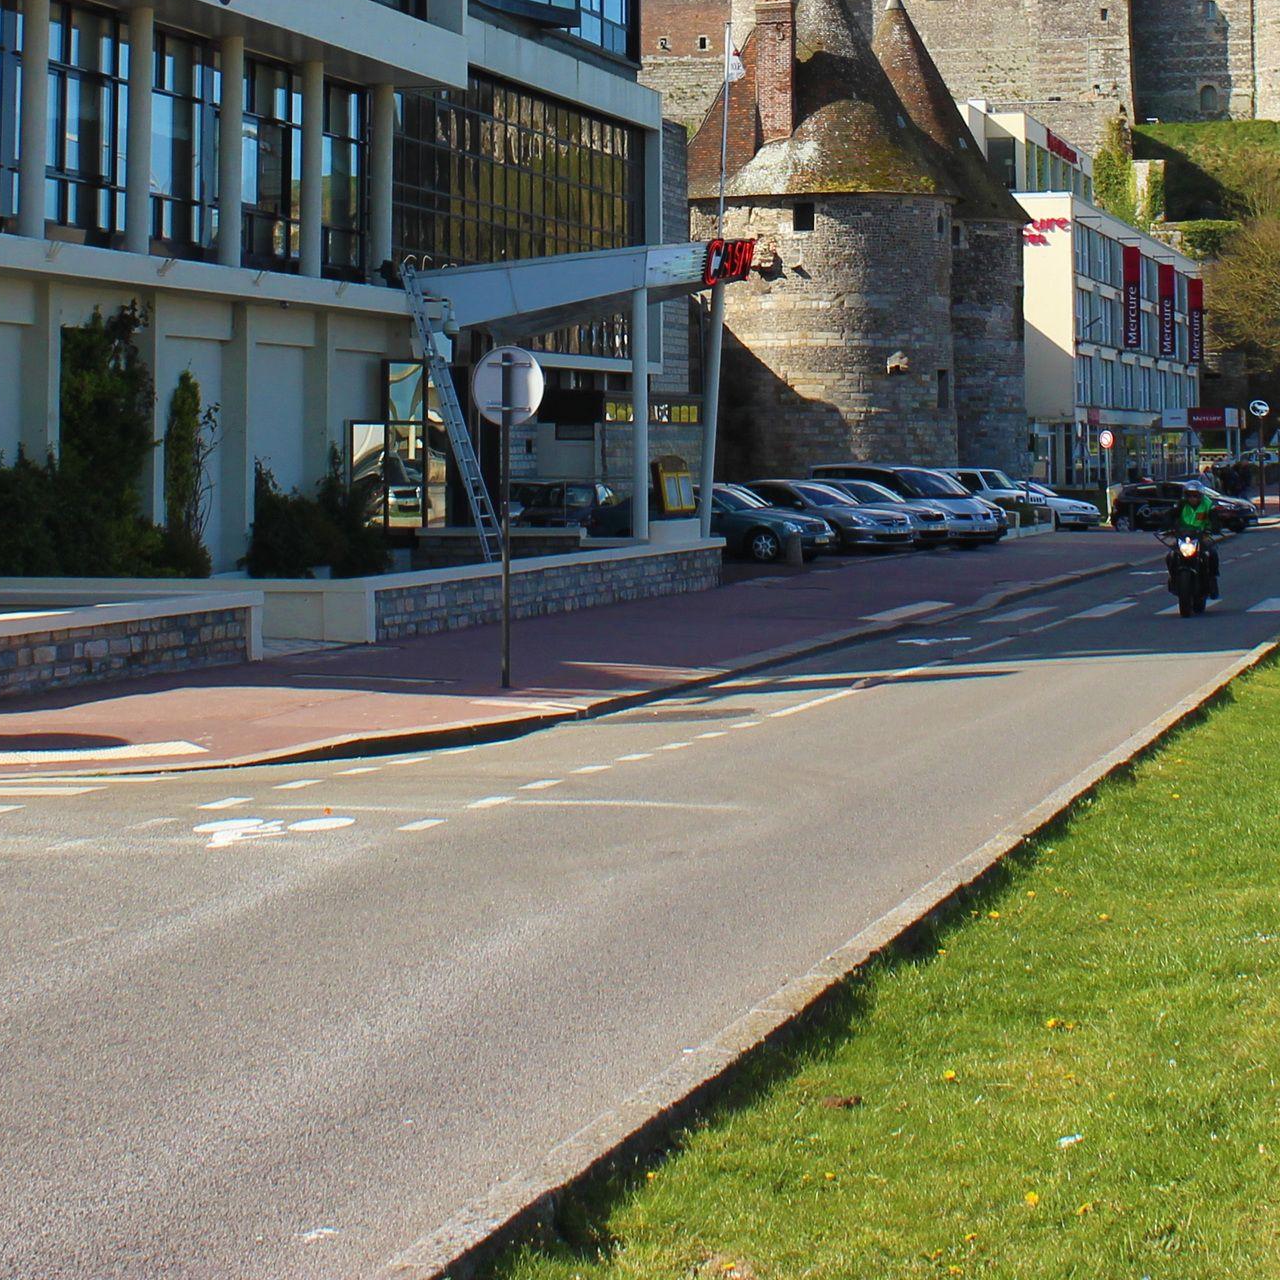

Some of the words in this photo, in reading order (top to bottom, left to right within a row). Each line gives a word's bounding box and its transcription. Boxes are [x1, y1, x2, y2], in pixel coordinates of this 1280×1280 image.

[1127, 285, 1138, 344] Mercure
[1162, 298, 1172, 352] Mercure
[1192, 310, 1201, 360] Mercure
